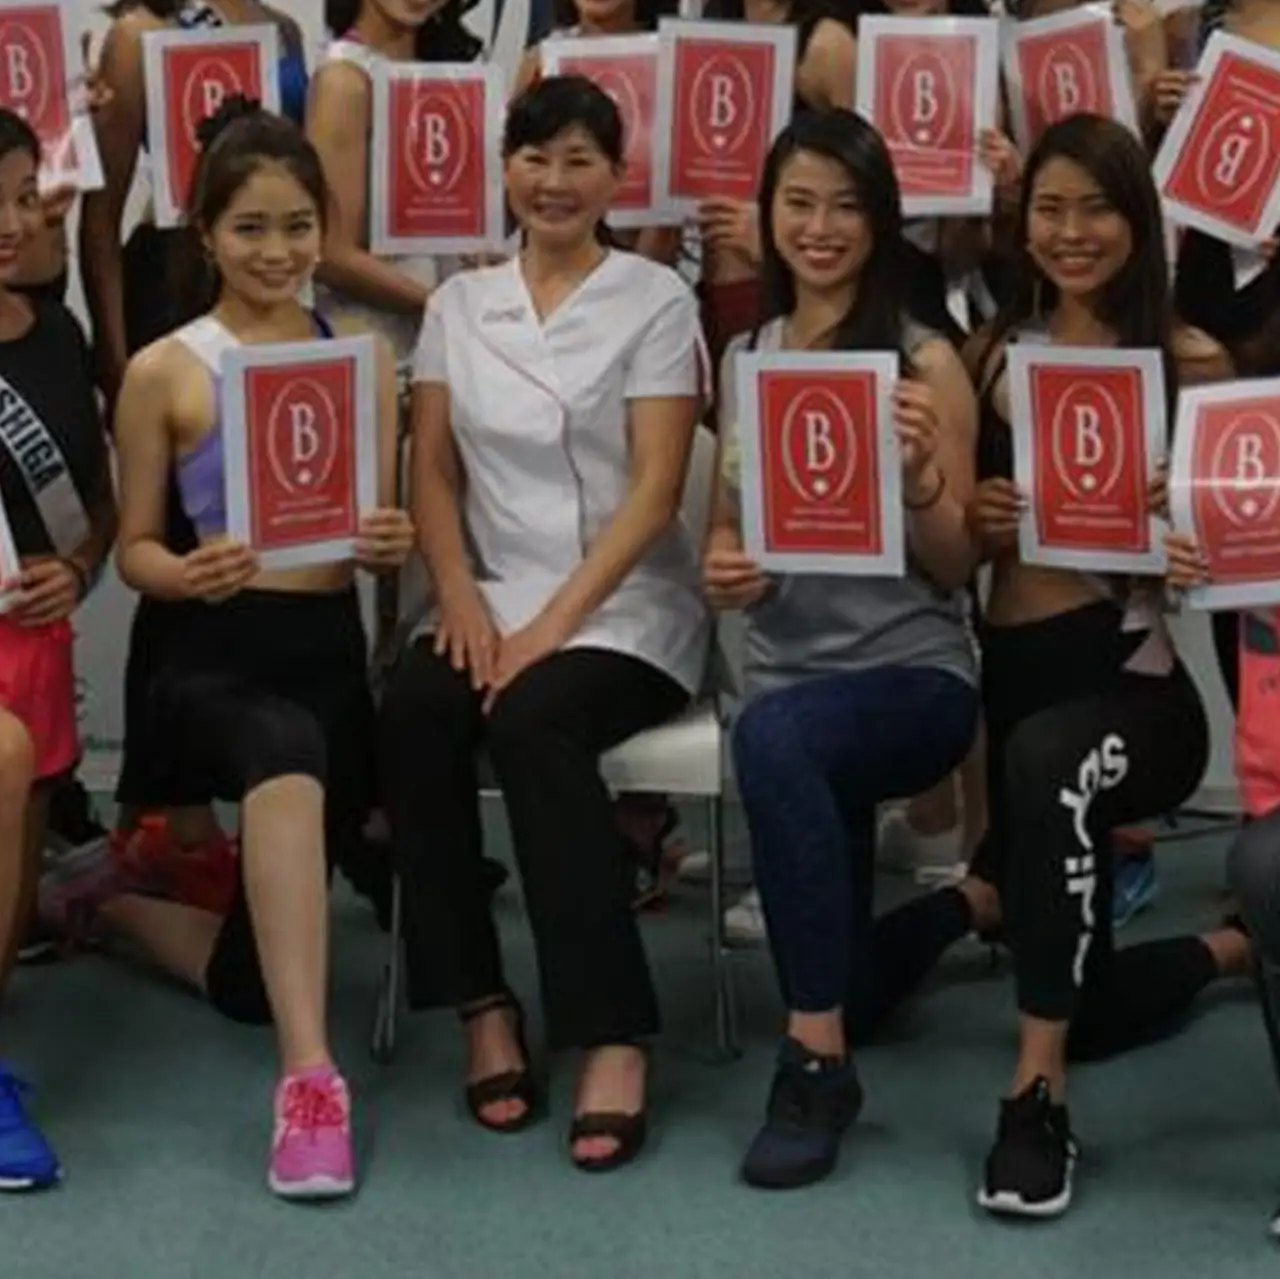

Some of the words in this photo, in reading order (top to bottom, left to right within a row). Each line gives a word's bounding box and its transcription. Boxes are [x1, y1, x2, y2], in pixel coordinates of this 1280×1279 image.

[7, 43, 33, 98] B
[914, 71, 938, 122] B
[709, 75, 737, 127] B
[424, 114, 450, 165] B
[1214, 135, 1249, 185] B
[290, 402, 318, 462] B
[807, 412, 835, 472] B
[1075, 403, 1103, 466] B
[1237, 434, 1264, 490] B
